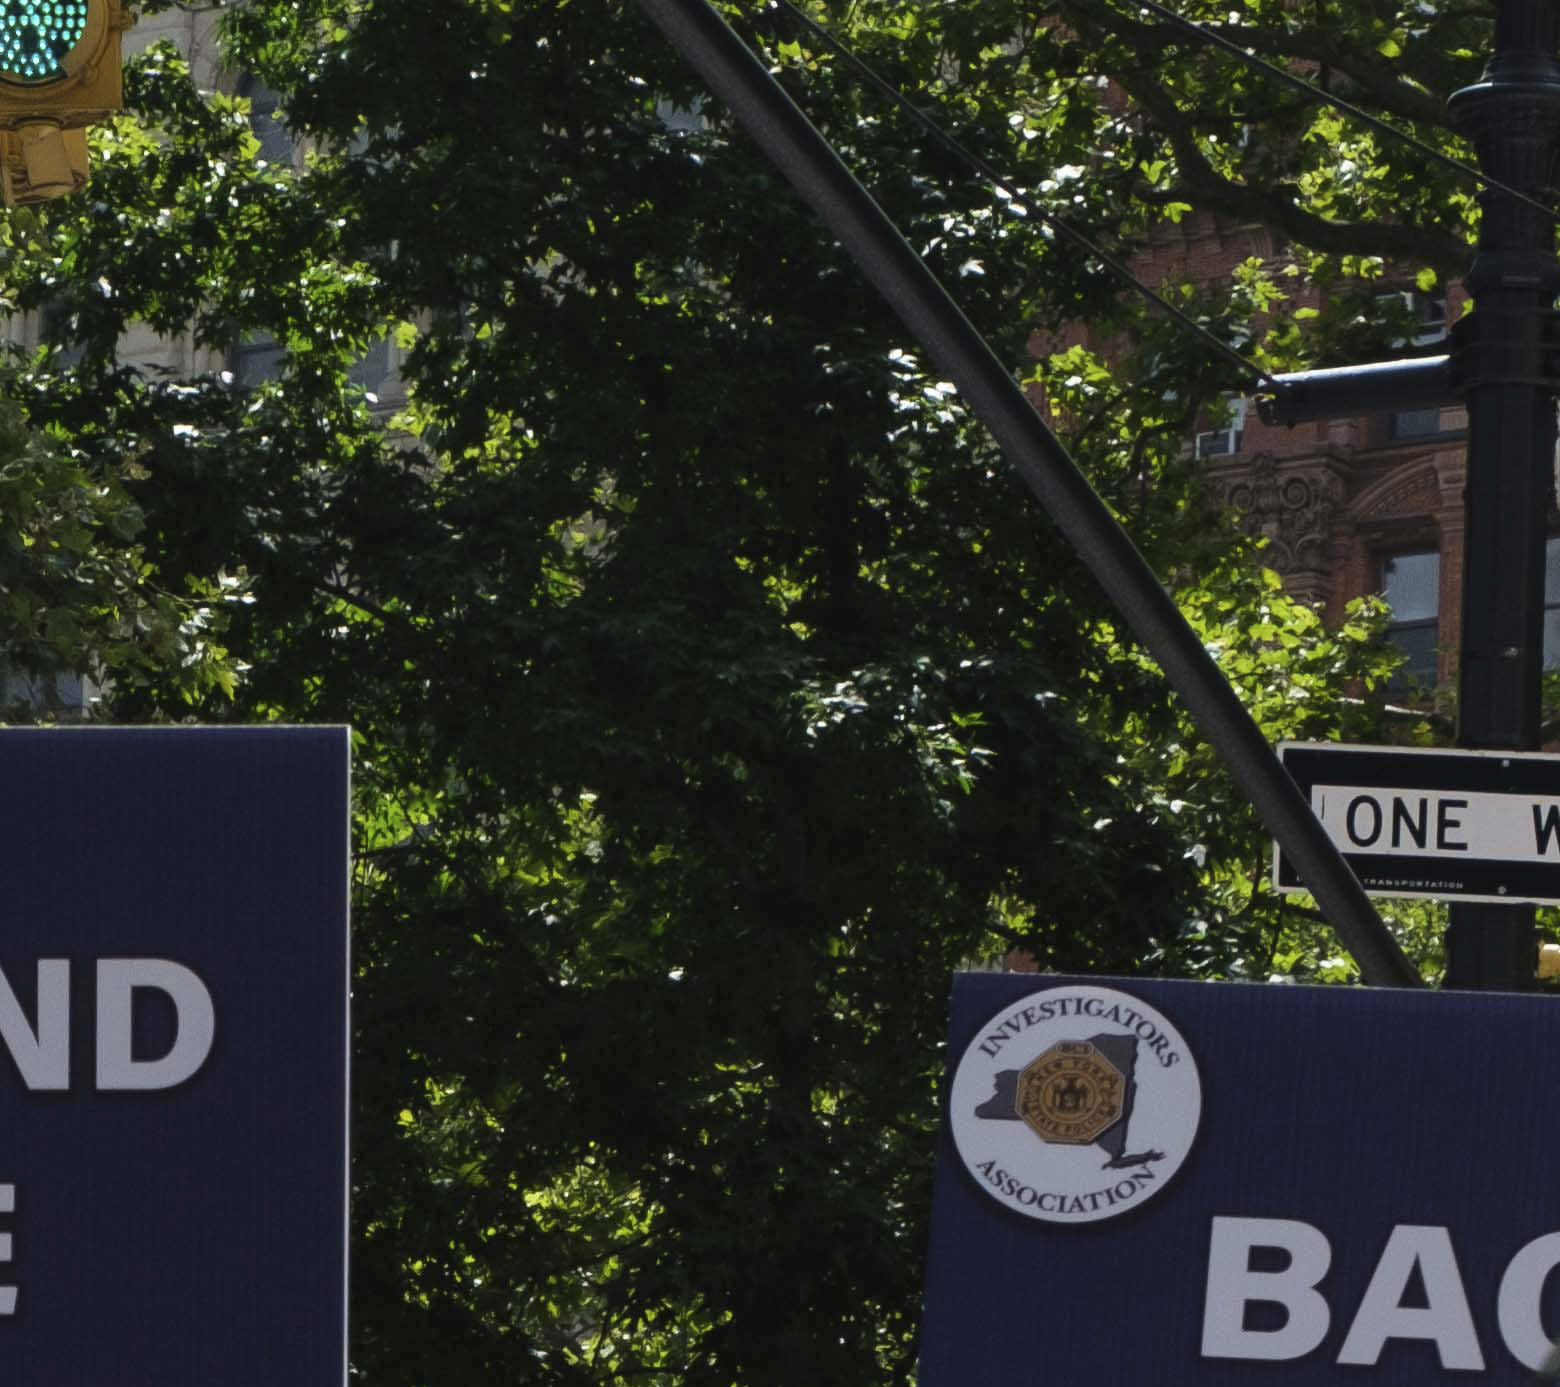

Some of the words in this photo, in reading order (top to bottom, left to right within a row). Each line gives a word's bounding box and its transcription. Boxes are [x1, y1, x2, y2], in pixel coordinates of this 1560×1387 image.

[1345, 793, 1470, 853] ONE
[978, 997, 1181, 1069] INVESTIGATORS
[976, 1160, 1156, 1214] ASSOCIATION
